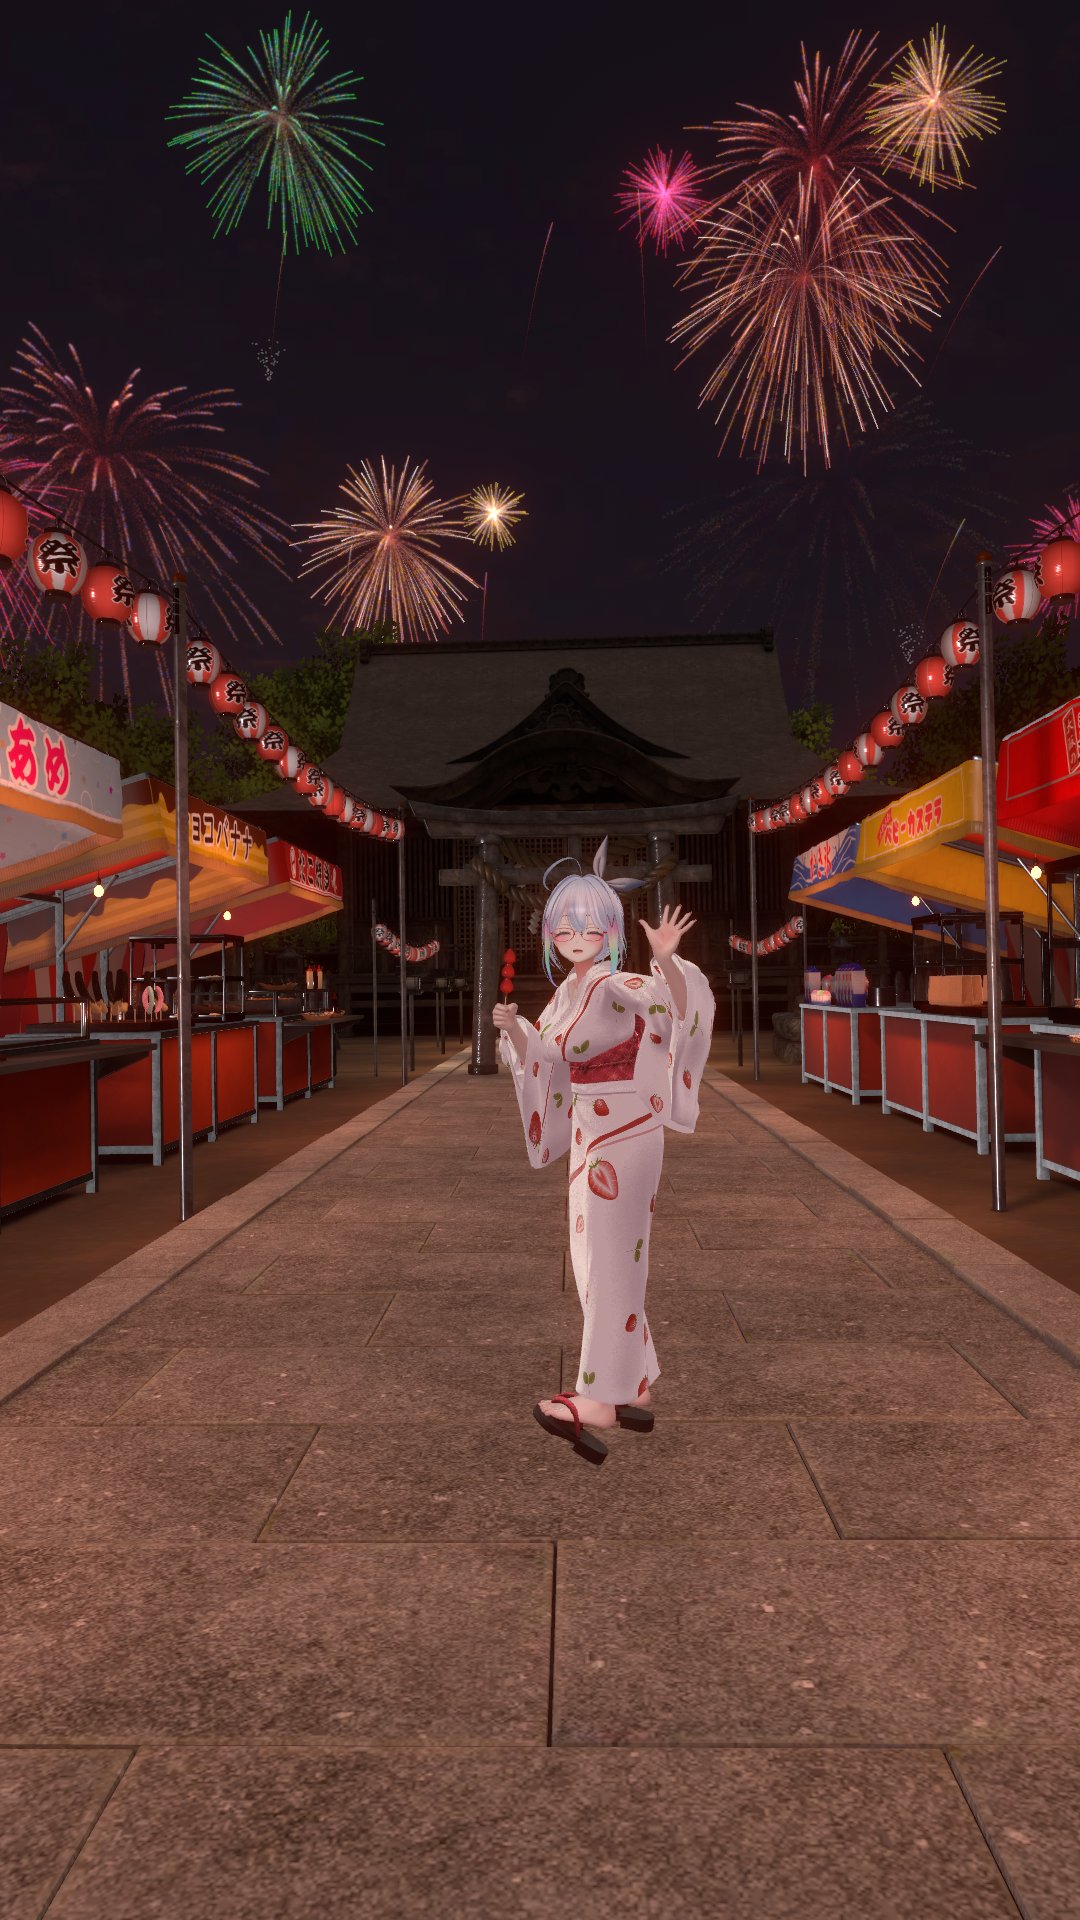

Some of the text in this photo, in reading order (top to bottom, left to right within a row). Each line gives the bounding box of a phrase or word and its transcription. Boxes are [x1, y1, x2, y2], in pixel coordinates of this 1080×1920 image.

[38, 539, 81, 577] 祭
[958, 628, 980, 653] 祭
[186, 647, 212, 671] 祭
[225, 680, 247, 703] 祭
[900, 692, 925, 714] 祭
[262, 730, 285, 750] 祭
[6, 713, 70, 798] あめ
[188, 812, 253, 863] ョコバナナ
